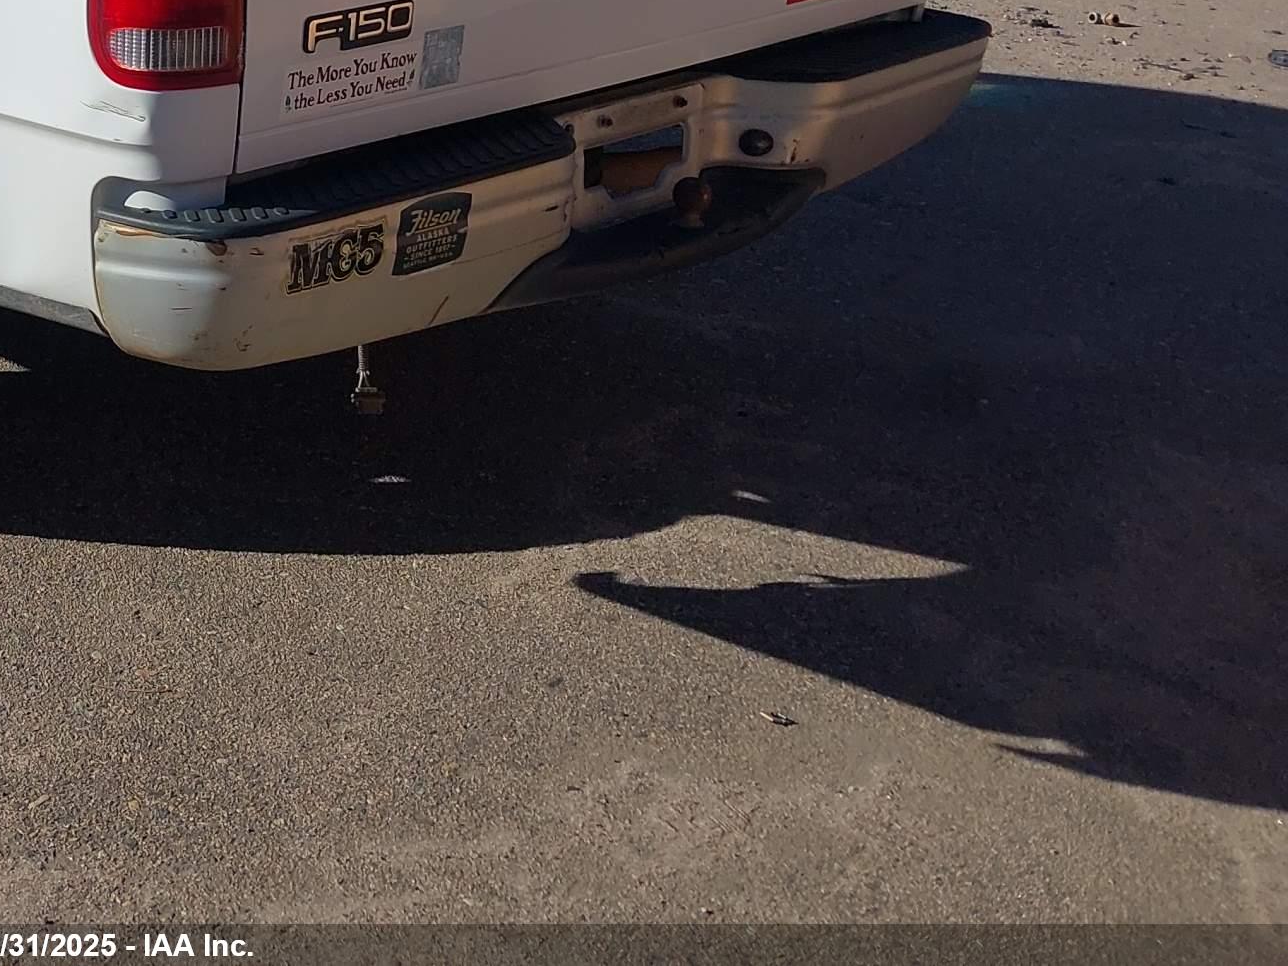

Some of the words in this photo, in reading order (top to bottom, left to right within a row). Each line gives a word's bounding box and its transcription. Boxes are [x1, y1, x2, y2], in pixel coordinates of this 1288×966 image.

[287, 70, 314, 90] The
[315, 65, 352, 84] More
[353, 58, 378, 76] You
[379, 52, 417, 70] Know
[294, 92, 315, 110] the
[316, 88, 348, 105] Less
[349, 81, 373, 98] You
[405, 208, 462, 237] Filson
[416, 226, 450, 243] ALASKA
[406, 234, 458, 254] OUTFITTERS
